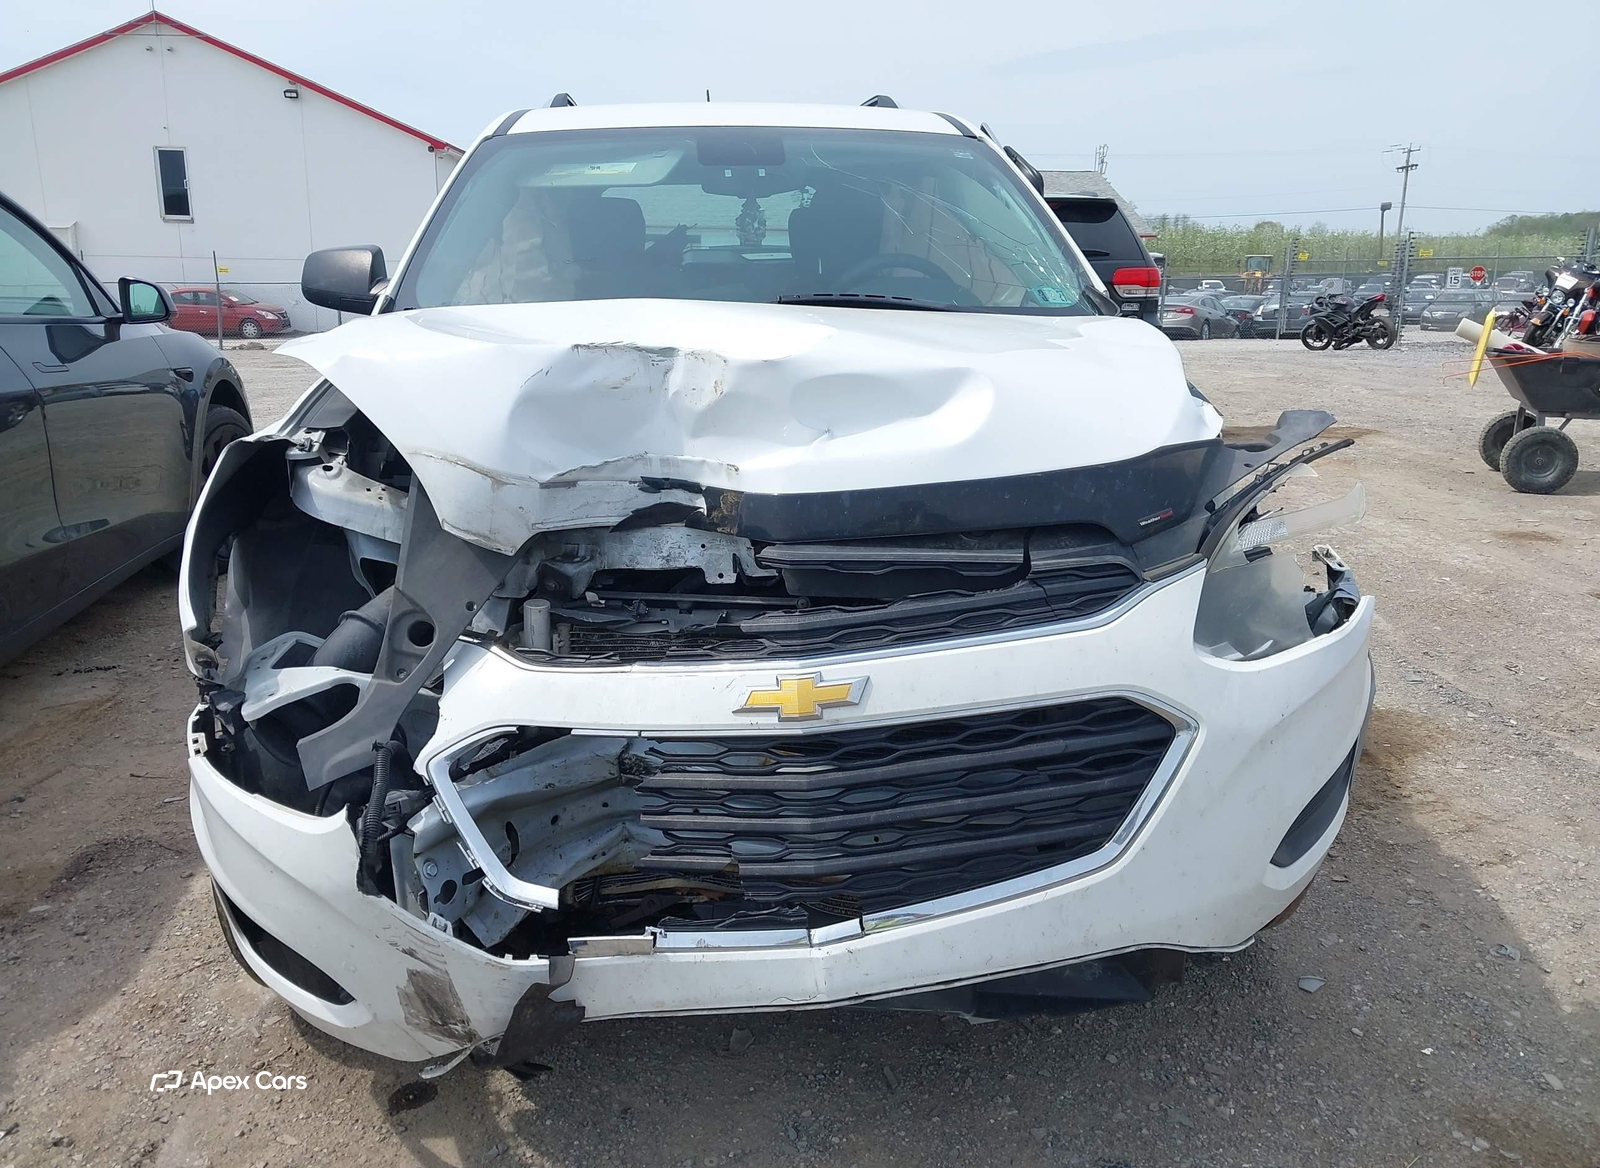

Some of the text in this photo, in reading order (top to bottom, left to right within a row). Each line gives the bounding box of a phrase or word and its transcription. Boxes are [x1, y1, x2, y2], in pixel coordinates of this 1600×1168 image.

[1470, 270, 1486, 278] STOP
[1449, 276, 1460, 285] 15
[1139, 509, 1173, 526] Weather
